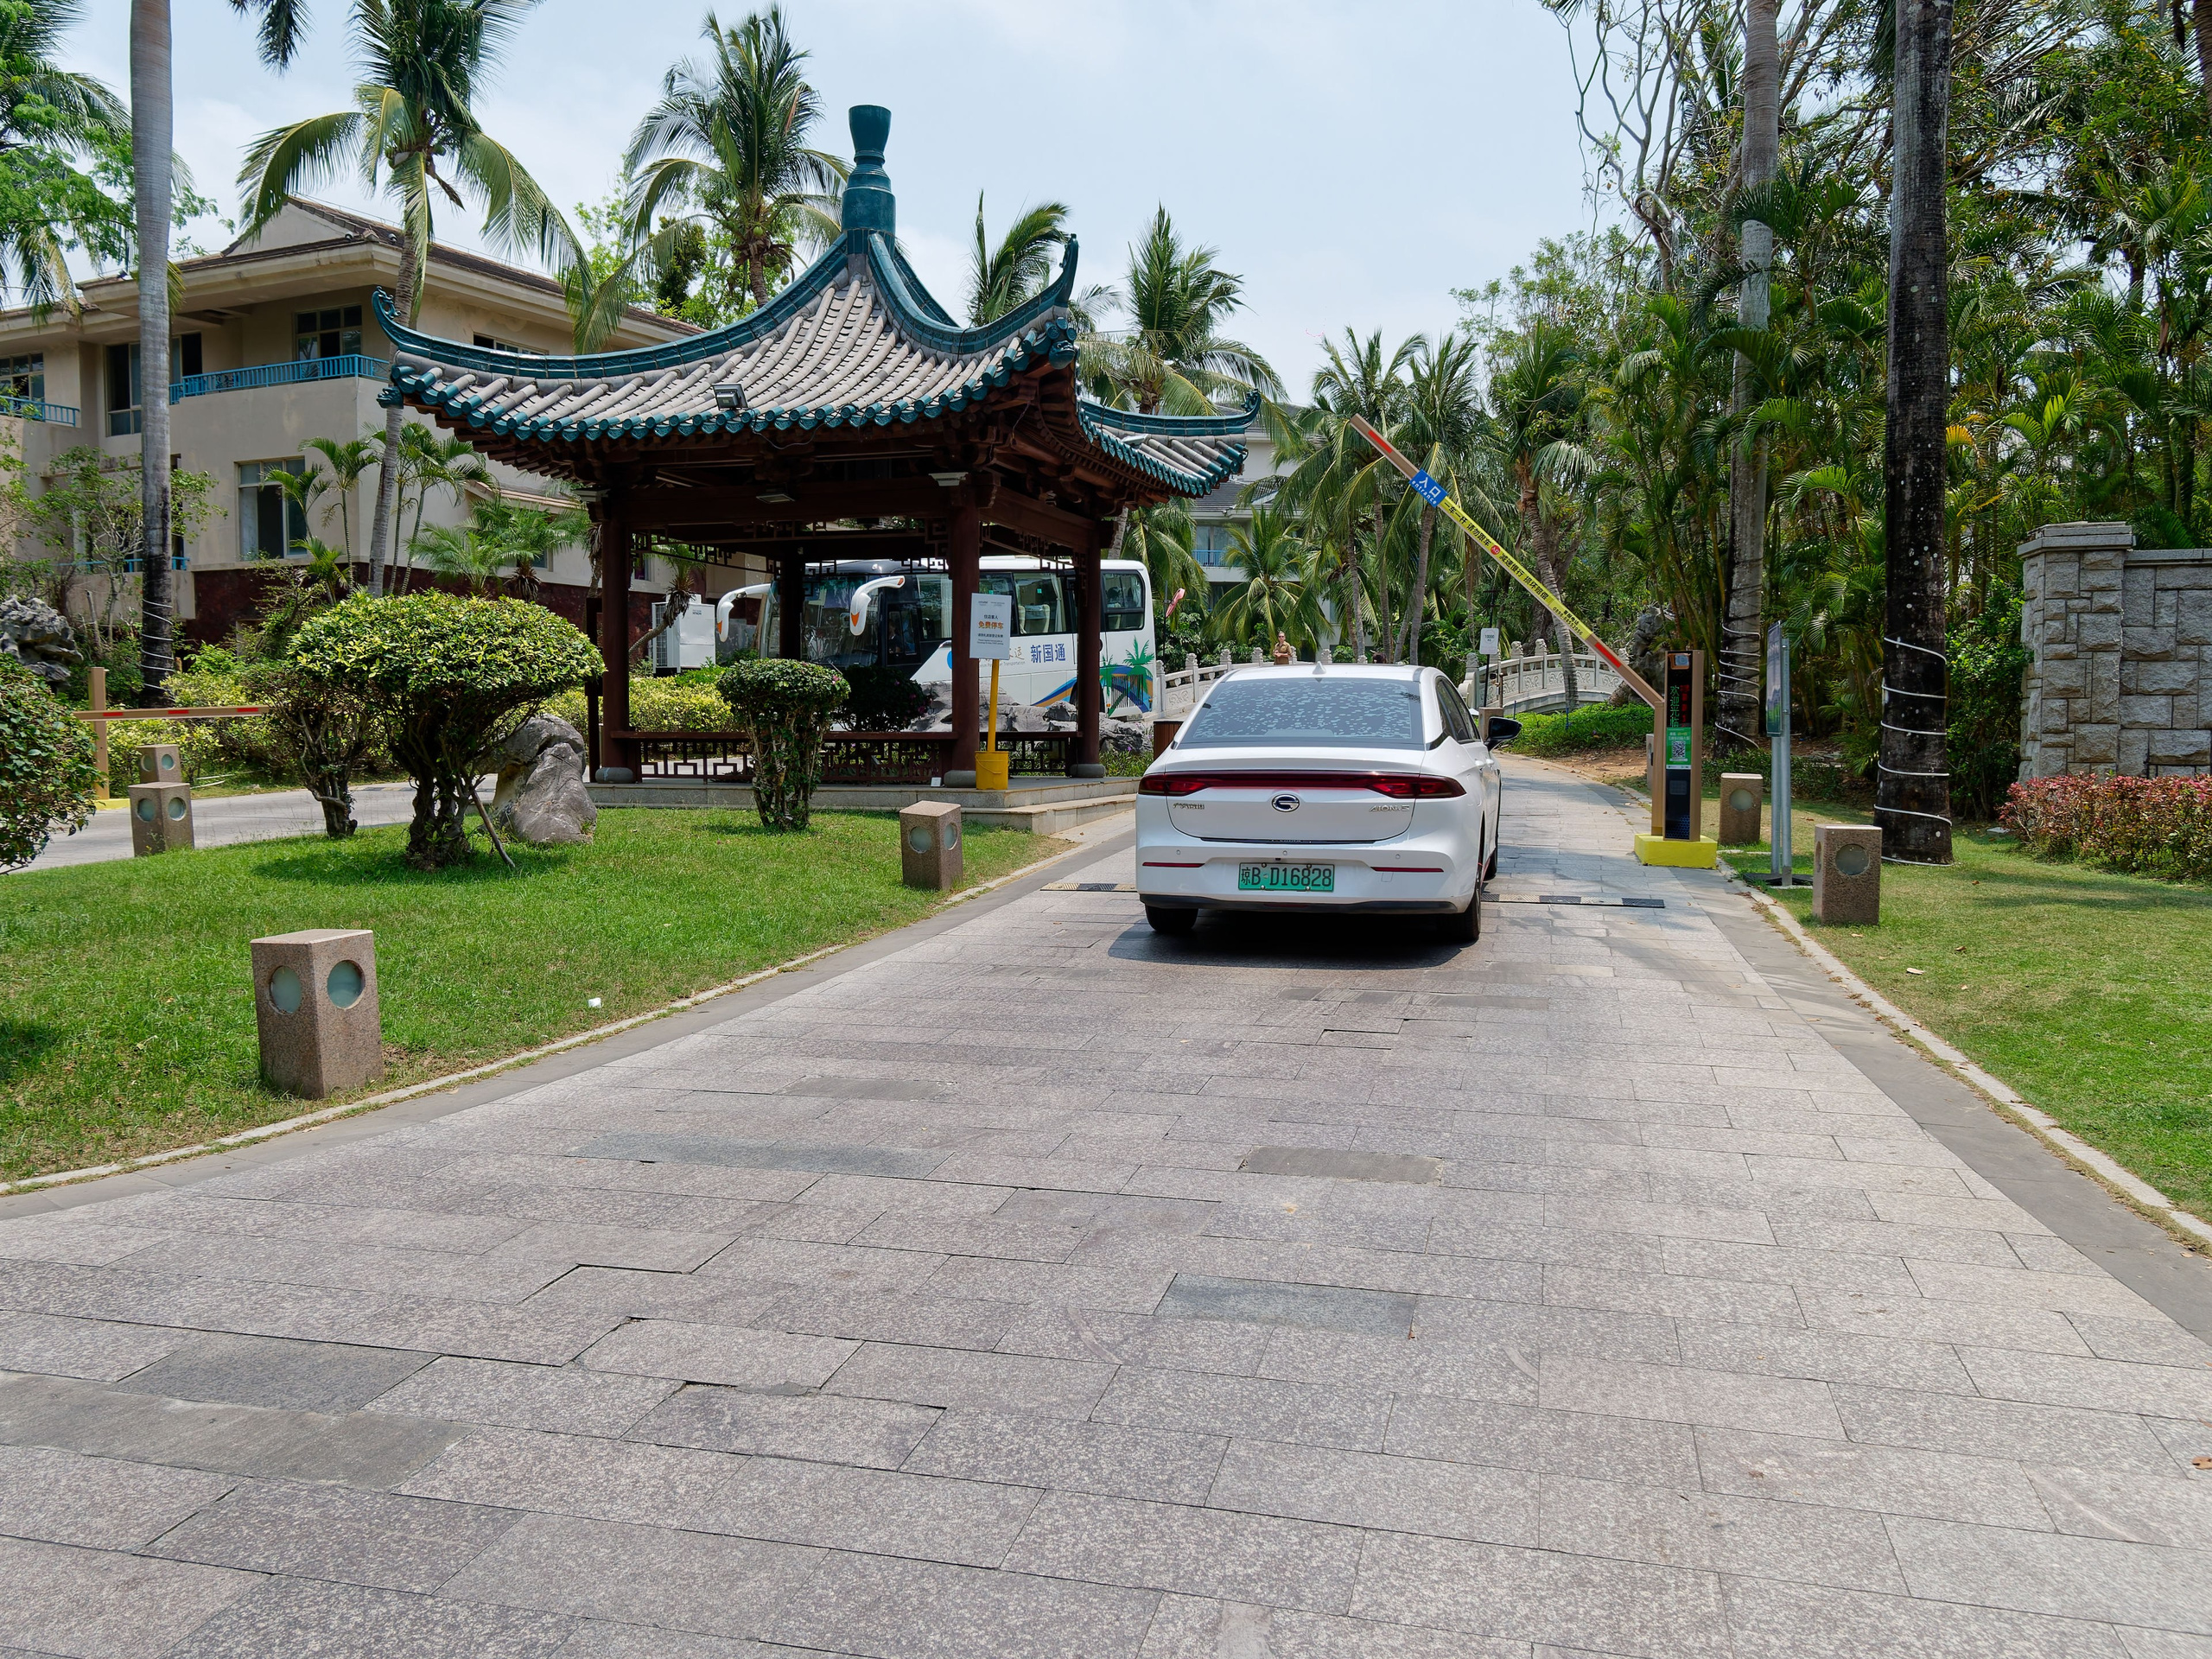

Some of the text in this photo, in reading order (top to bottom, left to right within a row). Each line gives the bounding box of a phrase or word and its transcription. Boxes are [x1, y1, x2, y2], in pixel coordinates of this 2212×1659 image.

[1411, 480, 1437, 505] entrance
[1419, 476, 1441, 499] 入口
[1444, 501, 1491, 546] 一车一杆 请勿跟车
[1499, 553, 1549, 601] 减速慢行 损坏赔偿
[978, 620, 1004, 630] 免费停车
[1030, 643, 1066, 664] 新国通
[1669, 684, 1680, 728] 欢迎光临
